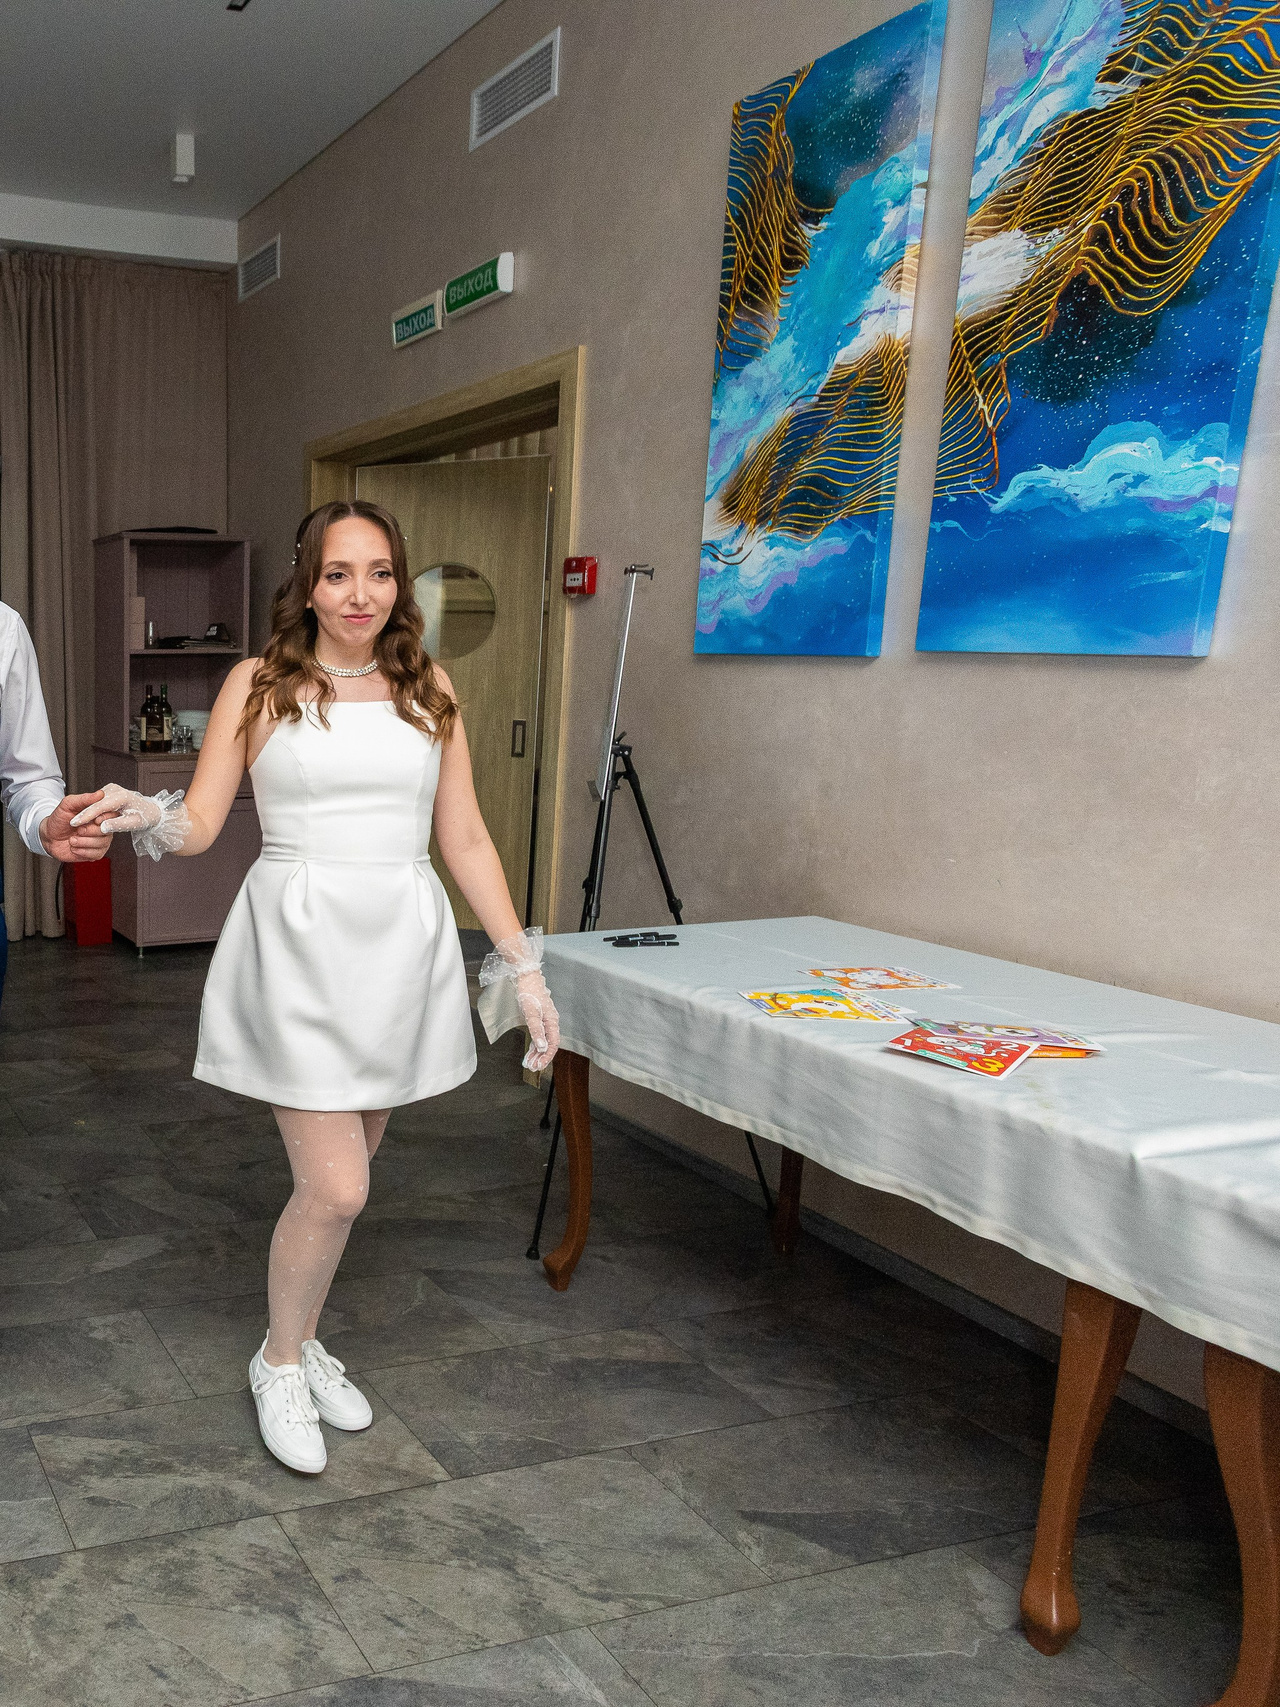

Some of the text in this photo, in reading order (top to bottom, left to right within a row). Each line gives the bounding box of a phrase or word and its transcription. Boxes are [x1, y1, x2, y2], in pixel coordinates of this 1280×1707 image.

[449, 267, 493, 304] ВЫХОД
[396, 309, 434, 340] ВЫХОД
[999, 1041, 1020, 1052] 2
[971, 1058, 1005, 1072] 3
